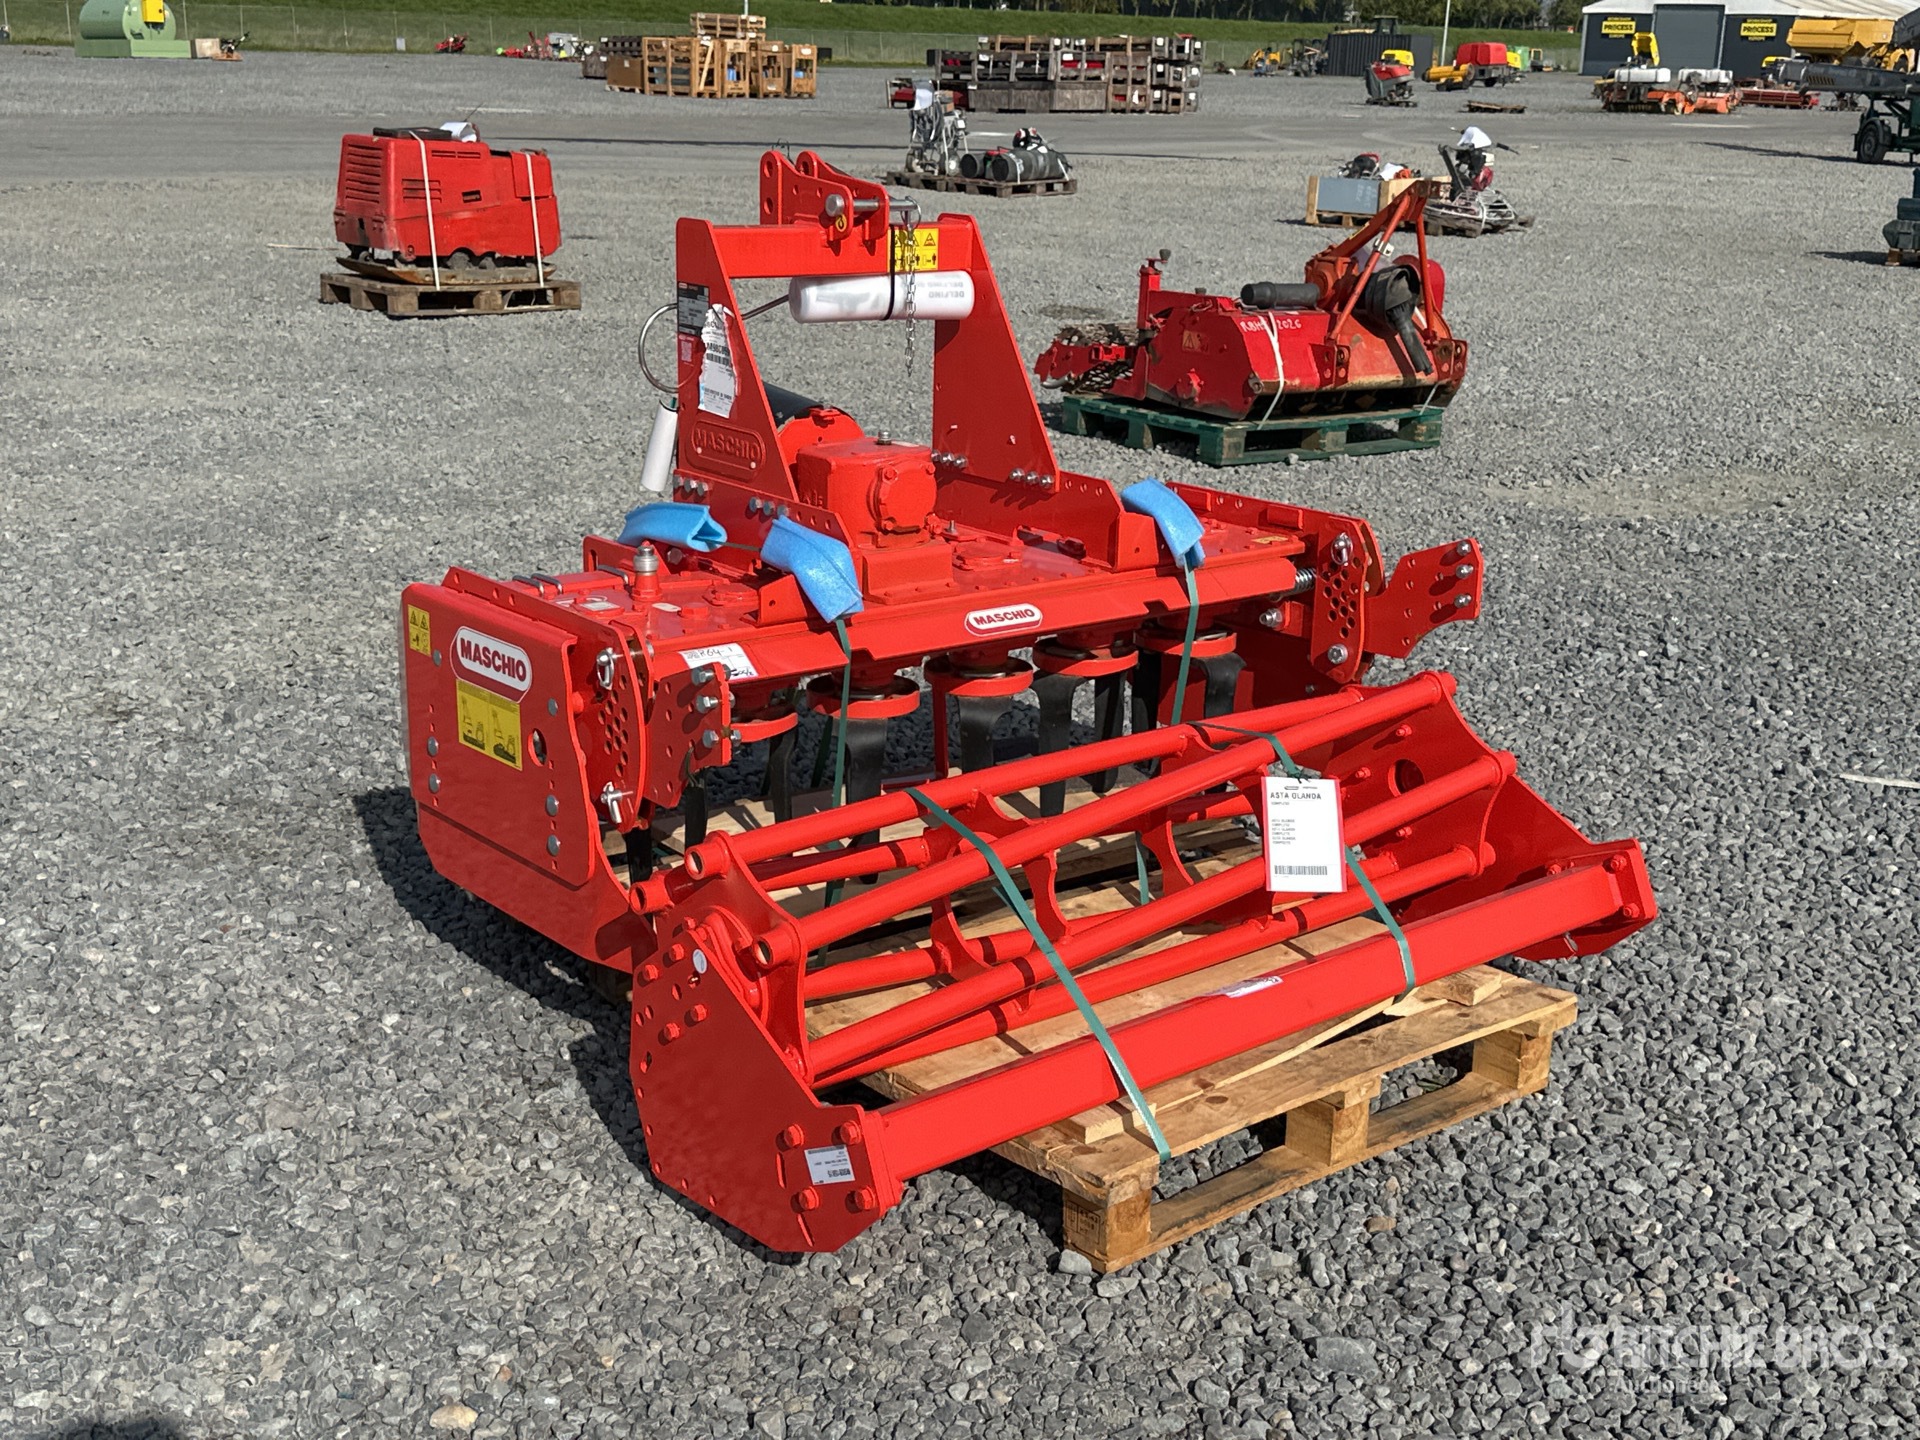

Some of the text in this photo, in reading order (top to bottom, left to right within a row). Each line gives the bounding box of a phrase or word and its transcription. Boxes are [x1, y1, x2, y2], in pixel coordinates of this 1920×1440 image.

[695, 428, 761, 460] MASCHIO
[973, 608, 1035, 626] MASCHIO
[460, 637, 527, 682] MASCHIO
